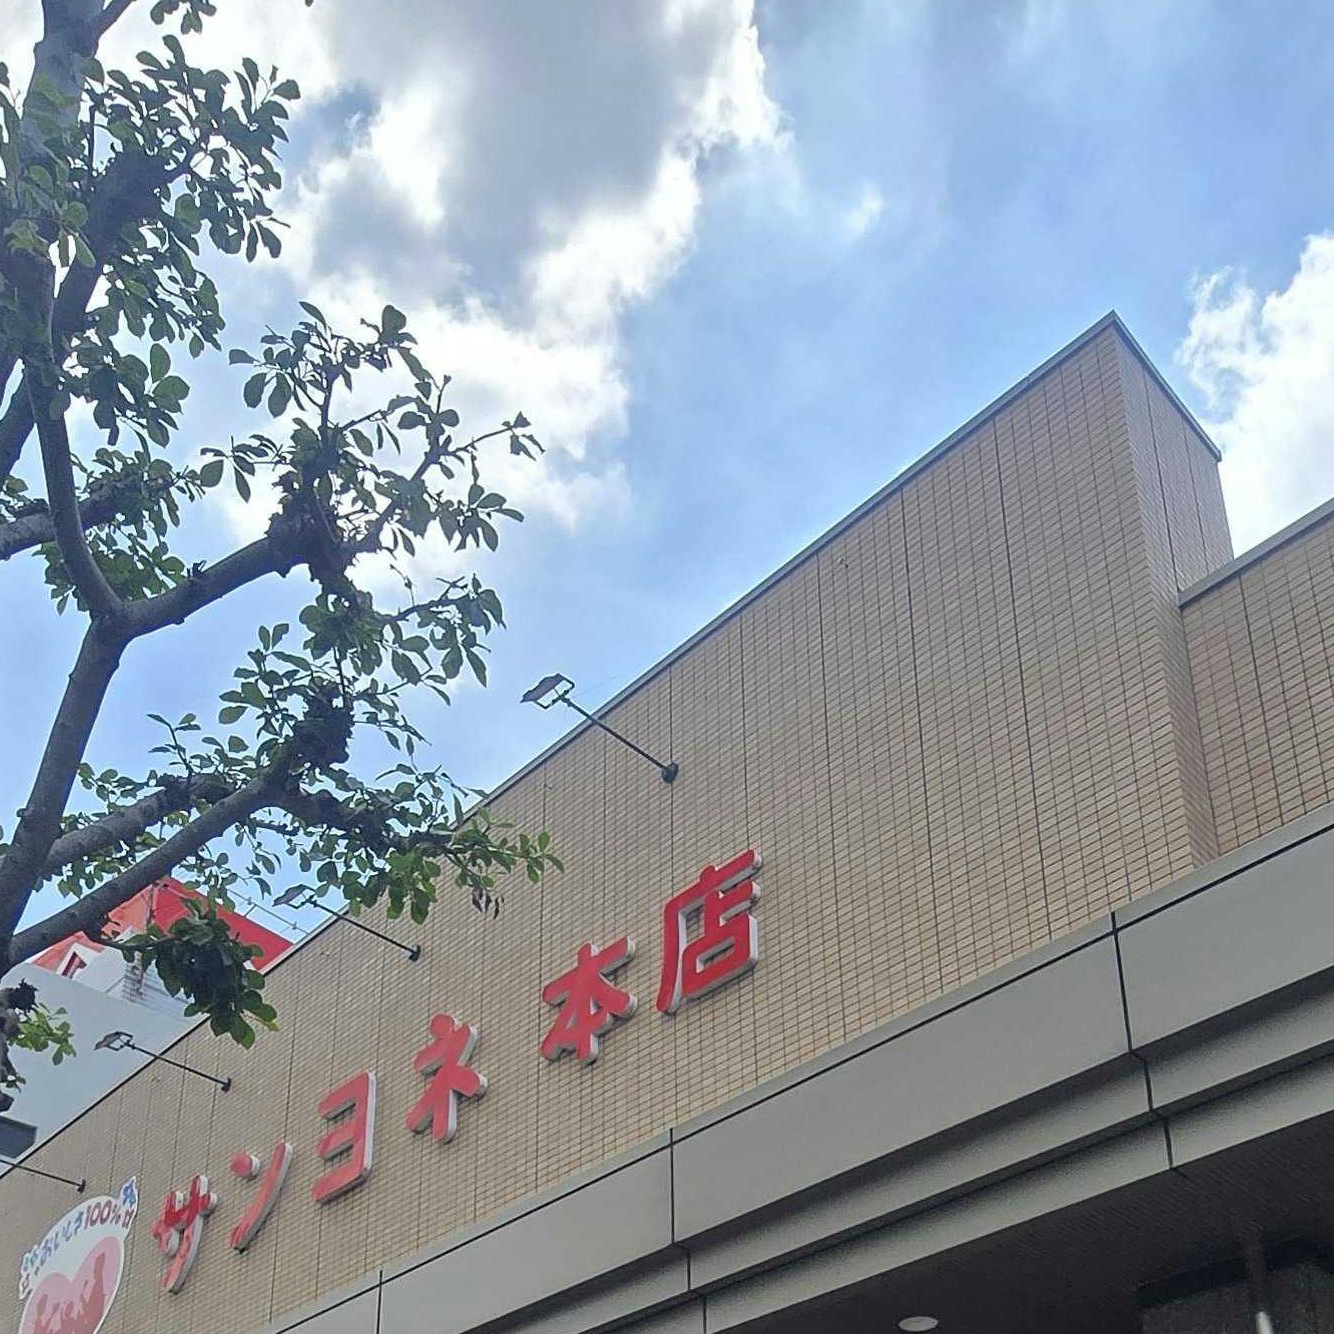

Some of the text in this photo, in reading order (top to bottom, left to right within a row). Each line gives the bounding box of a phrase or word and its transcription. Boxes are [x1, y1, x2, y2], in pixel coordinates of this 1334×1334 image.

[150, 848, 761, 1293] サンヨネ 本店
